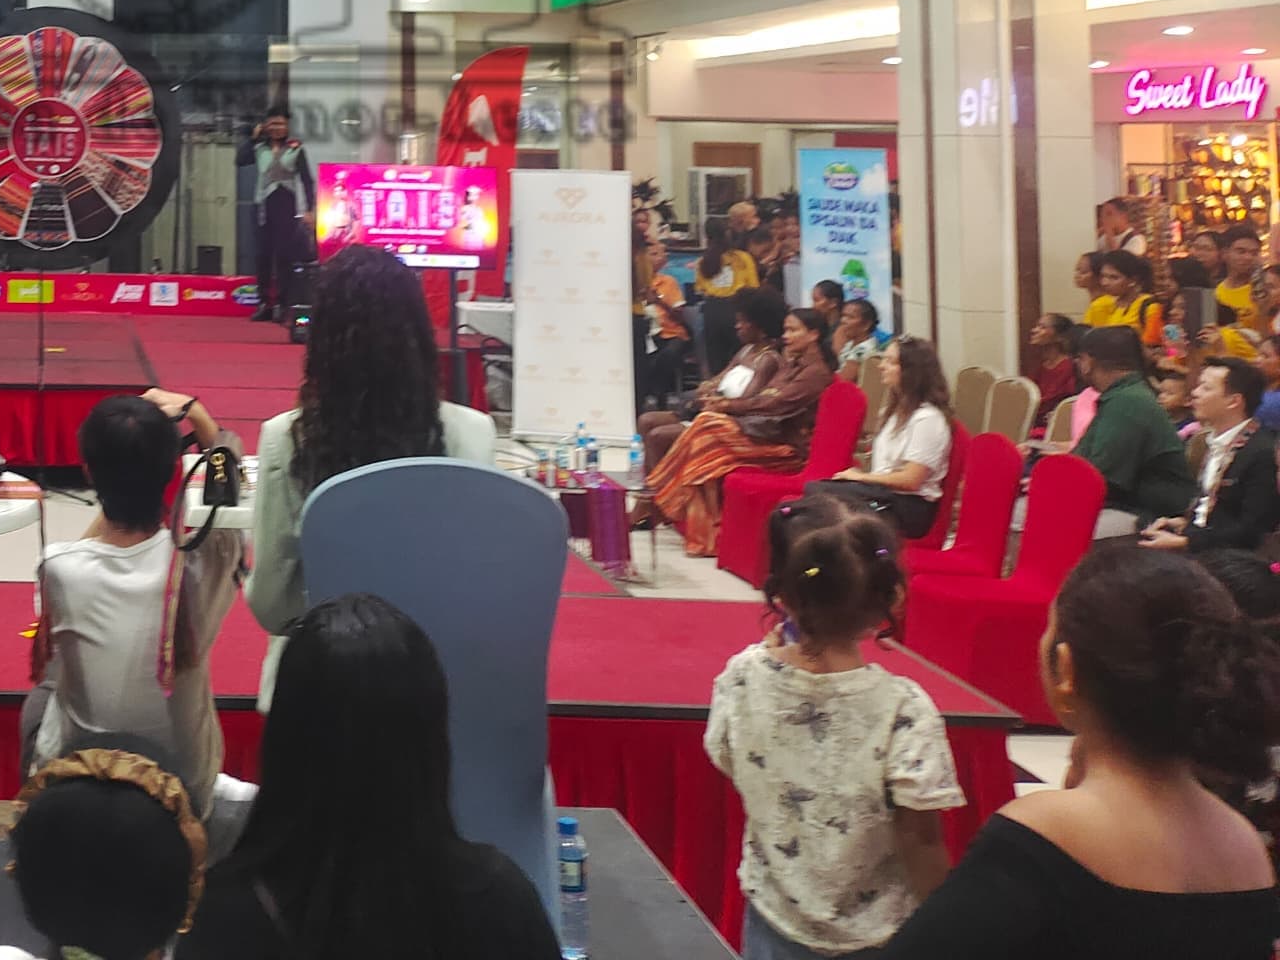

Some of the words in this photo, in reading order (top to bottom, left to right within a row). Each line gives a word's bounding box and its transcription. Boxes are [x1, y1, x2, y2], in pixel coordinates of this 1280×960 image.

[1125, 69, 1194, 116] Sweet
[1197, 62, 1265, 120] Lady
[353, 189, 461, 229] TAIS
